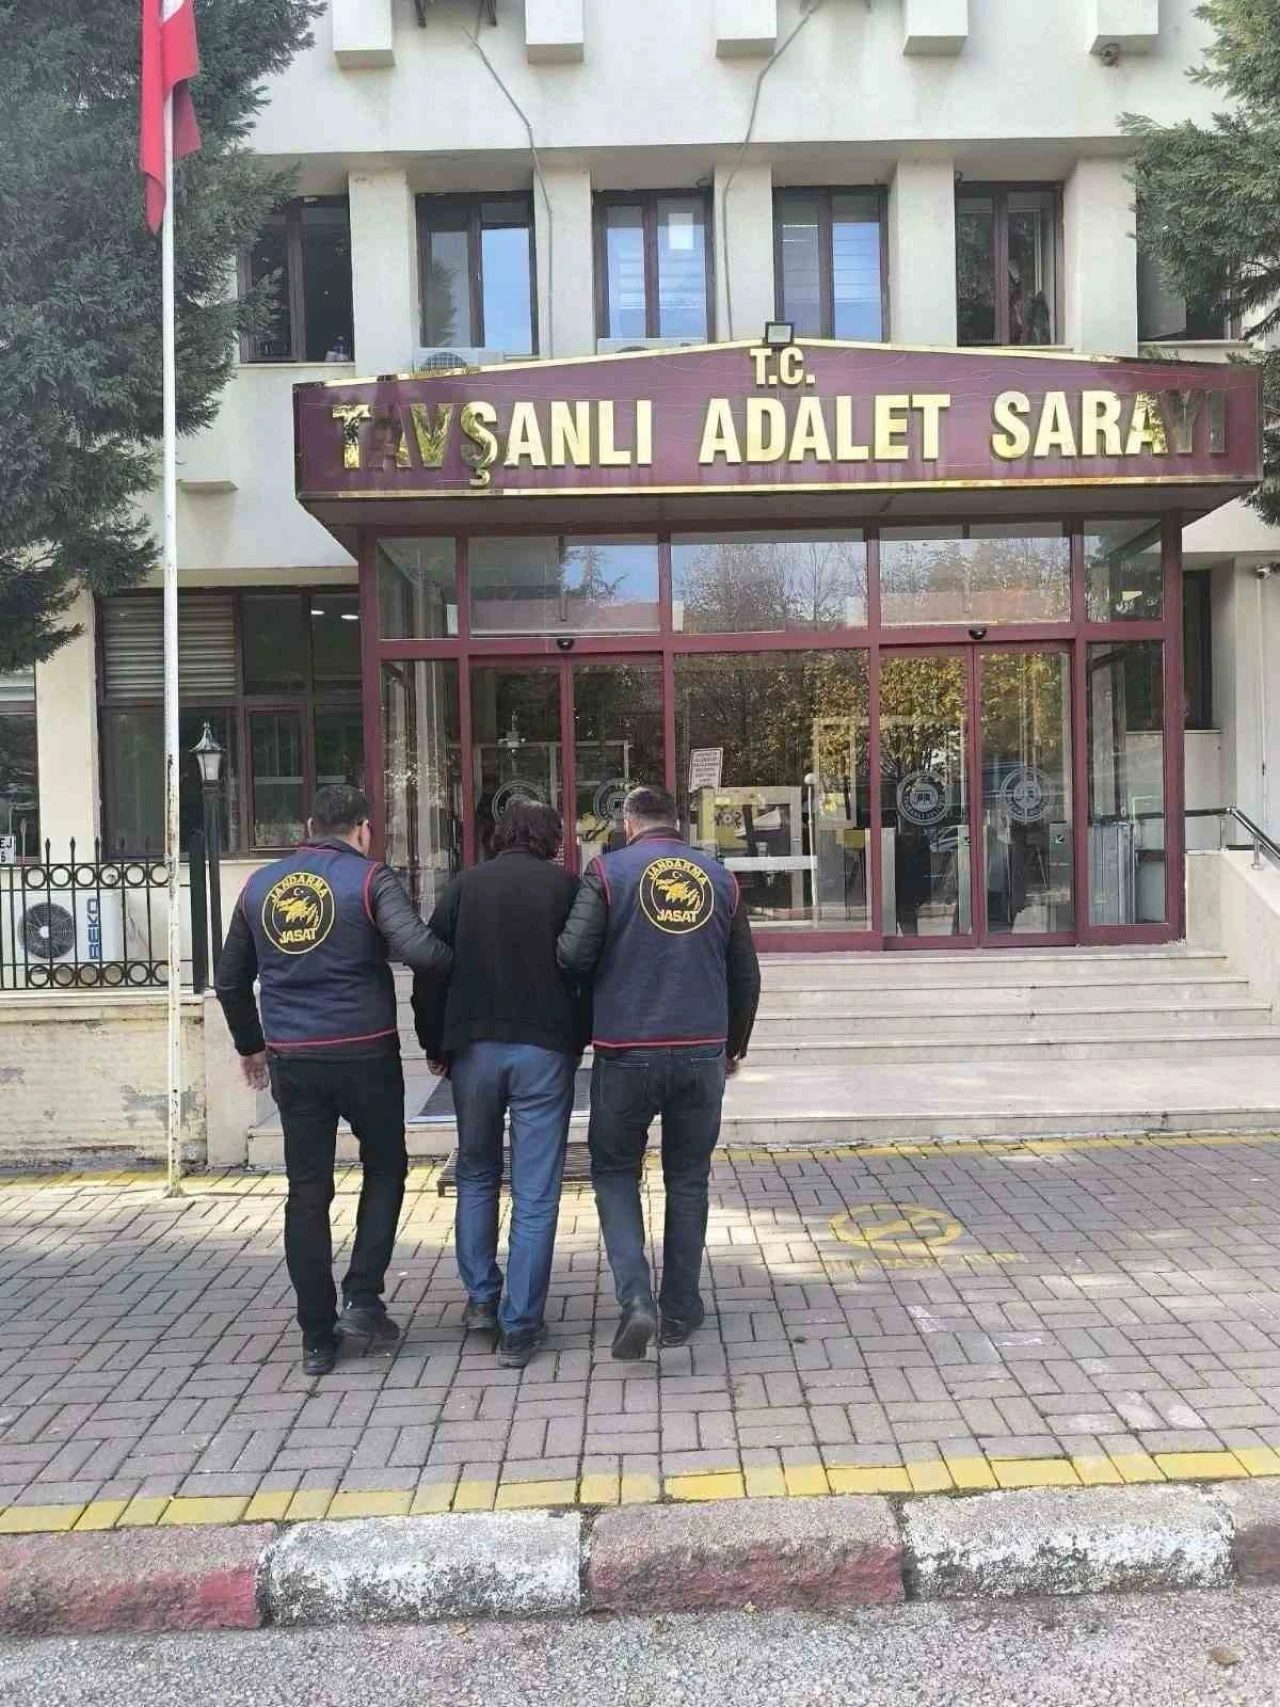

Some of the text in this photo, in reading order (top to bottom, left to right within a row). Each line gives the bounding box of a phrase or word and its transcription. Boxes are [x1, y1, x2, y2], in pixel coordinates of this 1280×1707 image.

[750, 347, 816, 385] T.C.
[332, 389, 1226, 486] TAVŞANLI ADALET SARAYI
[648, 859, 707, 886] JANDARMA
[270, 874, 330, 903] JANDARMA
[656, 908, 699, 923] JASAT
[279, 927, 318, 944] JASAT
